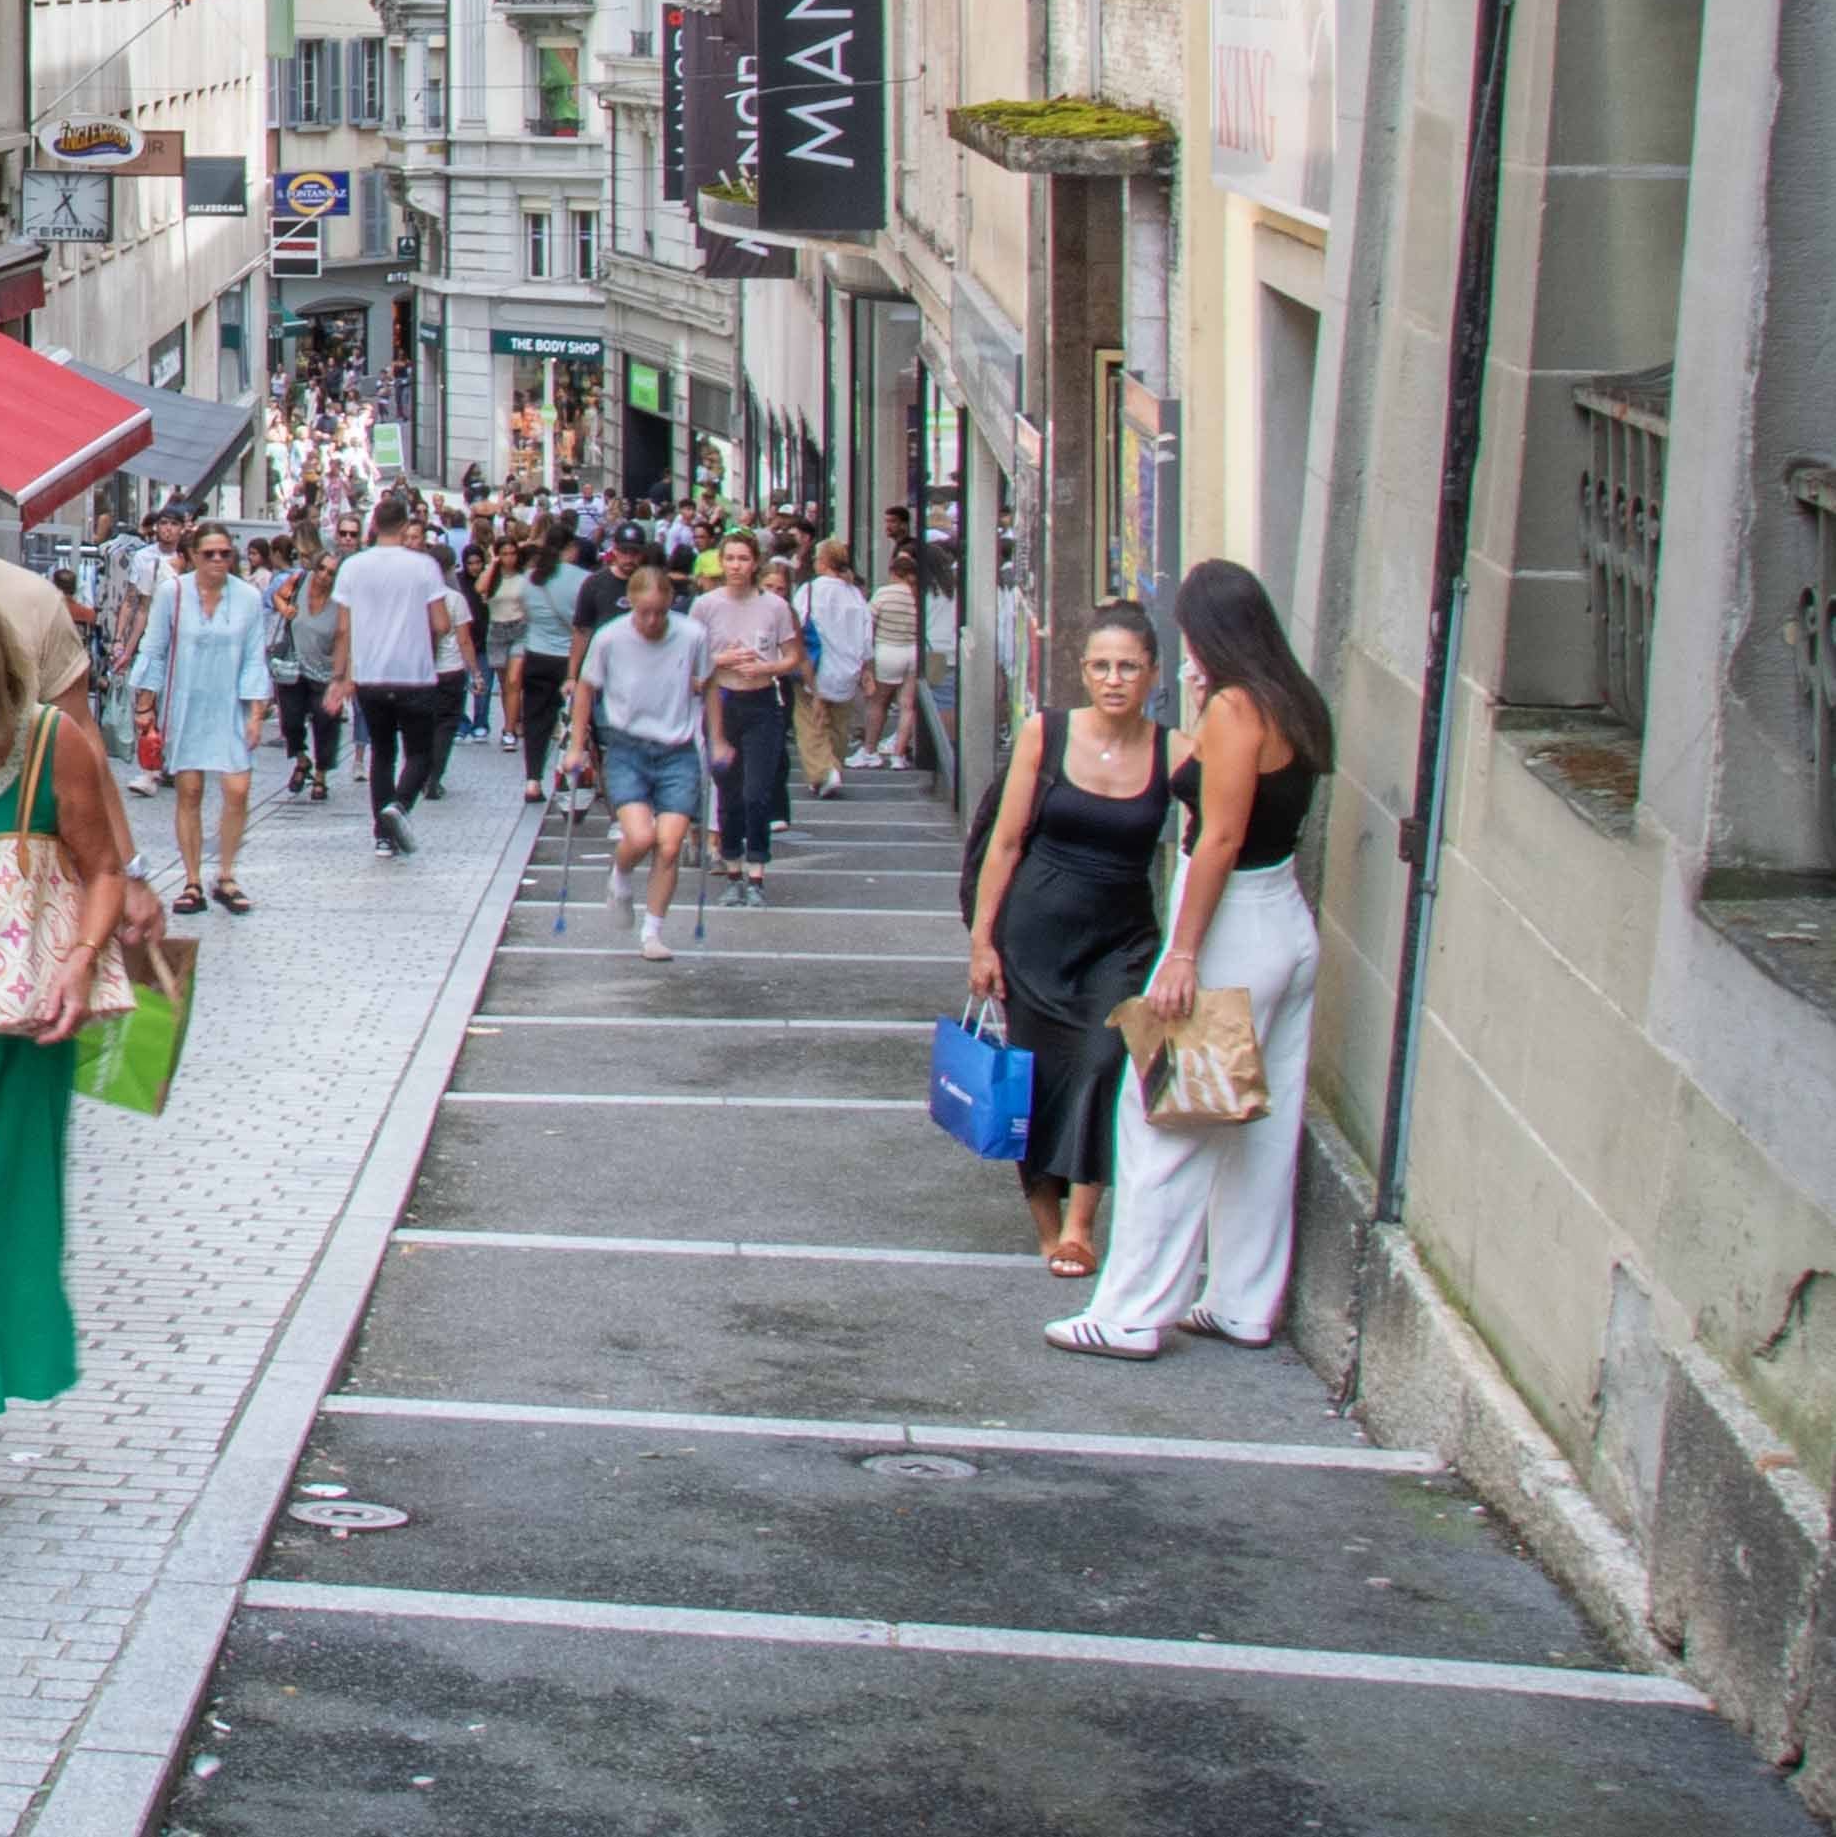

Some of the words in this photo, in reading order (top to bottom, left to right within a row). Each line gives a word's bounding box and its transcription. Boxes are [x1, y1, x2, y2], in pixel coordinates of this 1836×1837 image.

[1217, 45, 1275, 163] KING
[27, 226, 107, 238] CERTINA
[511, 337, 532, 352] THE
[535, 338, 565, 353] BODY
[568, 340, 600, 354] SHOP
